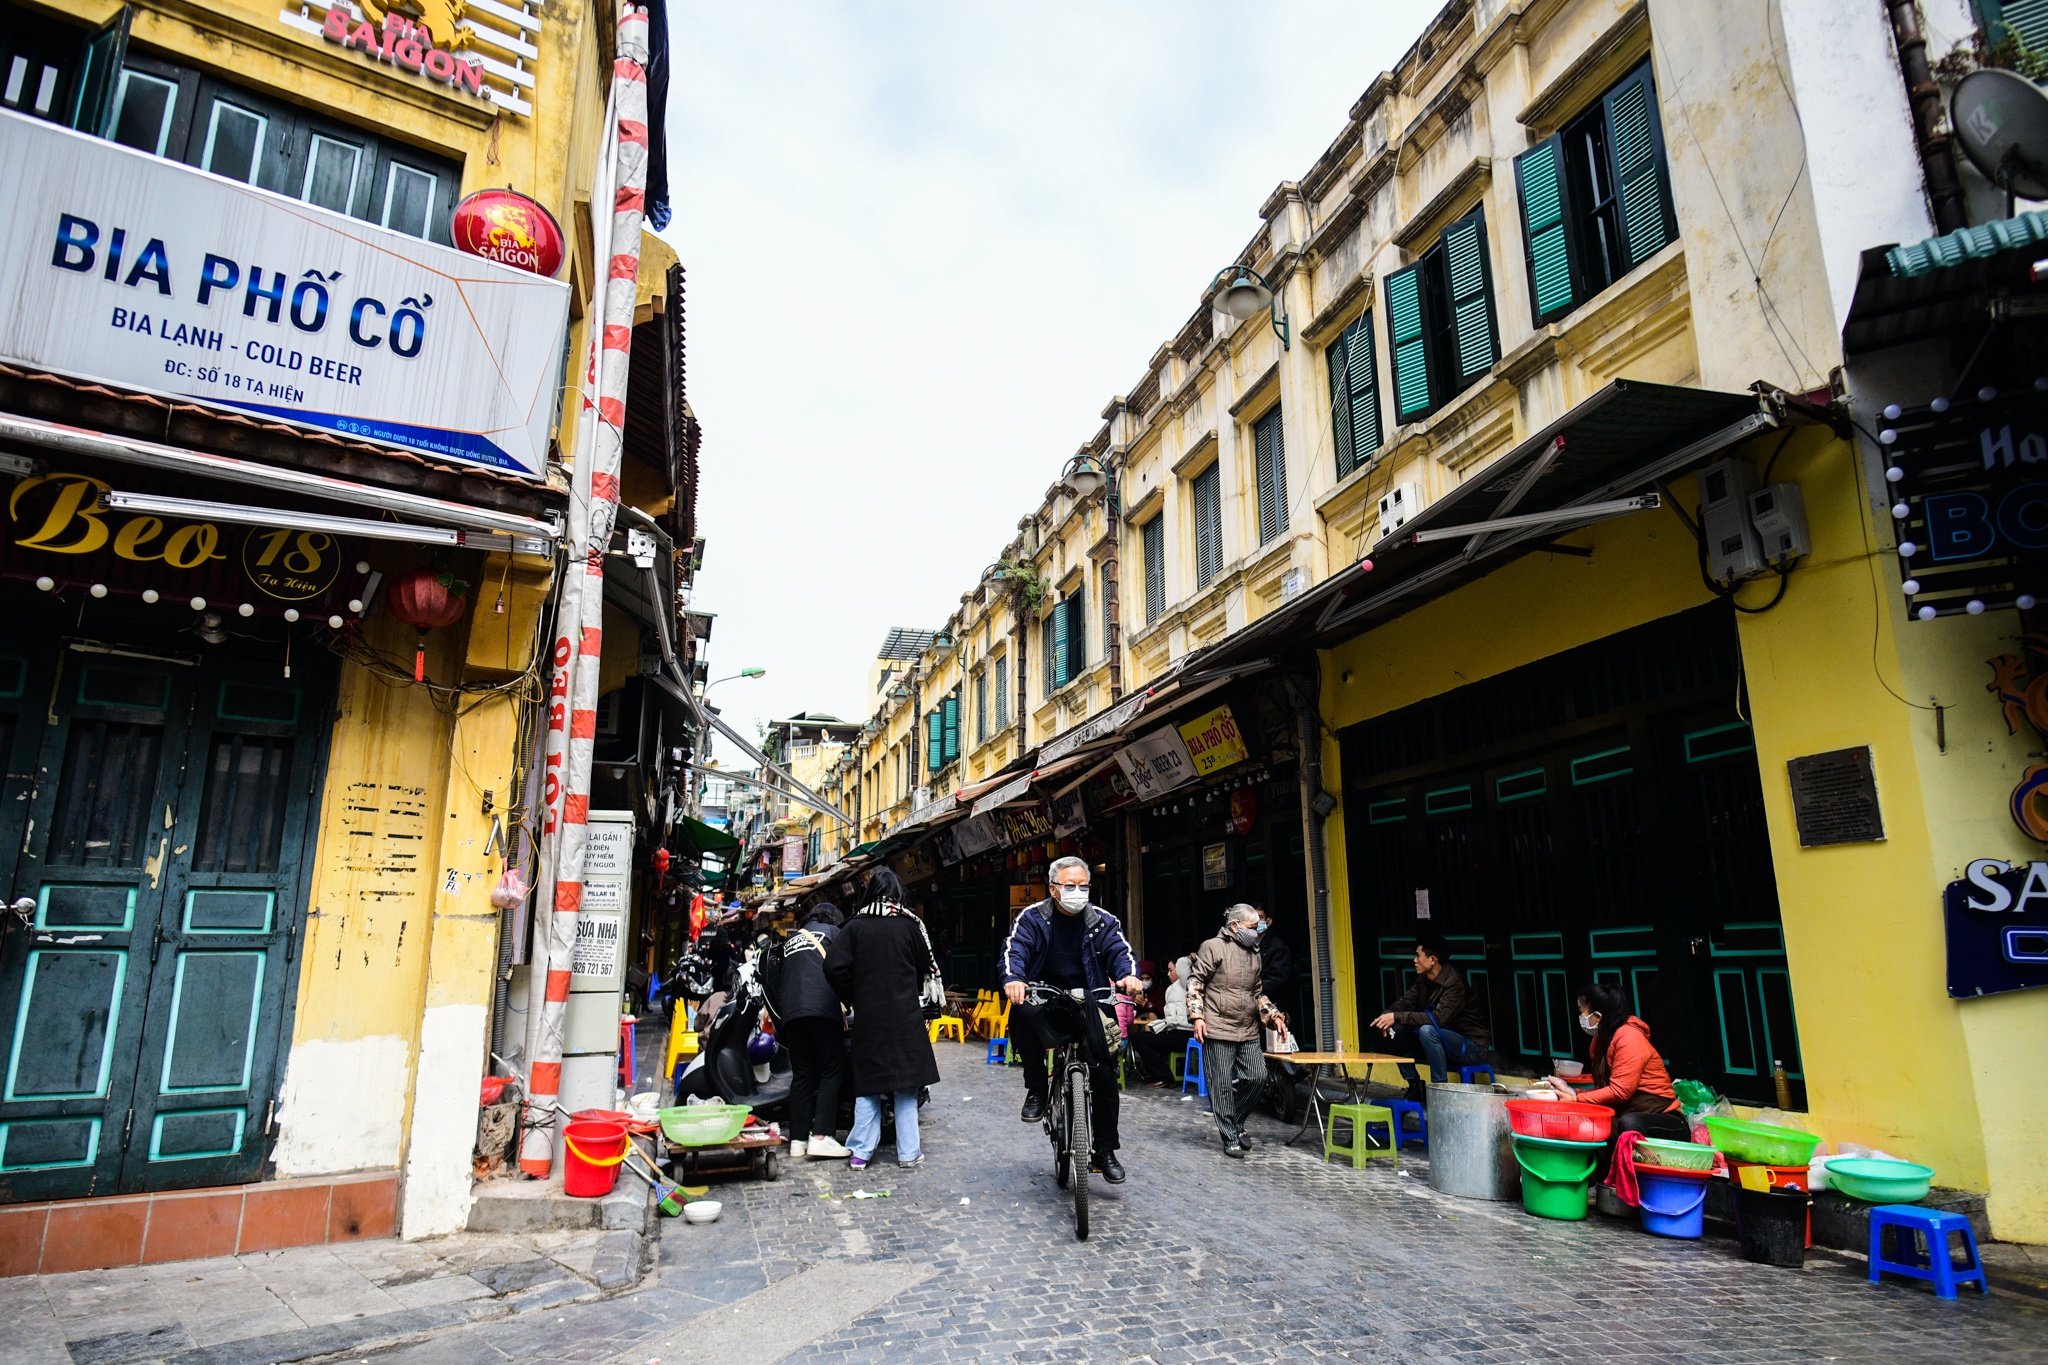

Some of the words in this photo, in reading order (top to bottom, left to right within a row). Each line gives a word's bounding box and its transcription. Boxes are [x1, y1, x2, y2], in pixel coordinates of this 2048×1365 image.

[387, 11, 433, 50] BIA
[323, 8, 485, 96] SAIGON
[478, 245, 540, 270] SAIGON
[500, 238, 520, 249] BIA
[51, 212, 173, 297] BIA
[196, 252, 344, 334] PHỐ
[349, 292, 434, 360] CỔ
[111, 306, 153, 336] BIA
[159, 318, 224, 352] LẠNH
[245, 340, 303, 372] COLD
[309, 356, 363, 387] BEER
[164, 358, 192, 378] ĐC:
[197, 366, 222, 384] SỐ
[224, 372, 241, 388] 18
[245, 377, 264, 395] TẠ
[268, 383, 304, 403] HIỆN
[373, 429, 393, 440] NGƯỜI
[408, 437, 416, 445] 18
[429, 442, 449, 452] KHÔNG
[465, 450, 481, 460] UỐNG
[498, 457, 510, 467] BIA.
[9, 472, 227, 569] Beo
[255, 528, 331, 574] 18
[257, 573, 280, 588] Tạ
[282, 576, 318, 593] Hiện
[1186, 735, 1207, 757] BIA
[1201, 717, 1223, 750] PHỐ
[1130, 766, 1154, 789] Tiger
[1151, 754, 1175, 774] BEER
[1167, 749, 1183, 767] 23
[588, 833, 601, 843] LẠI
[593, 844, 610, 852] ĐIỆN
[576, 914, 595, 938] SỬA
[597, 919, 618, 940] NHÀ
[587, 962, 599, 975] 721
[600, 963, 614, 975] 567
